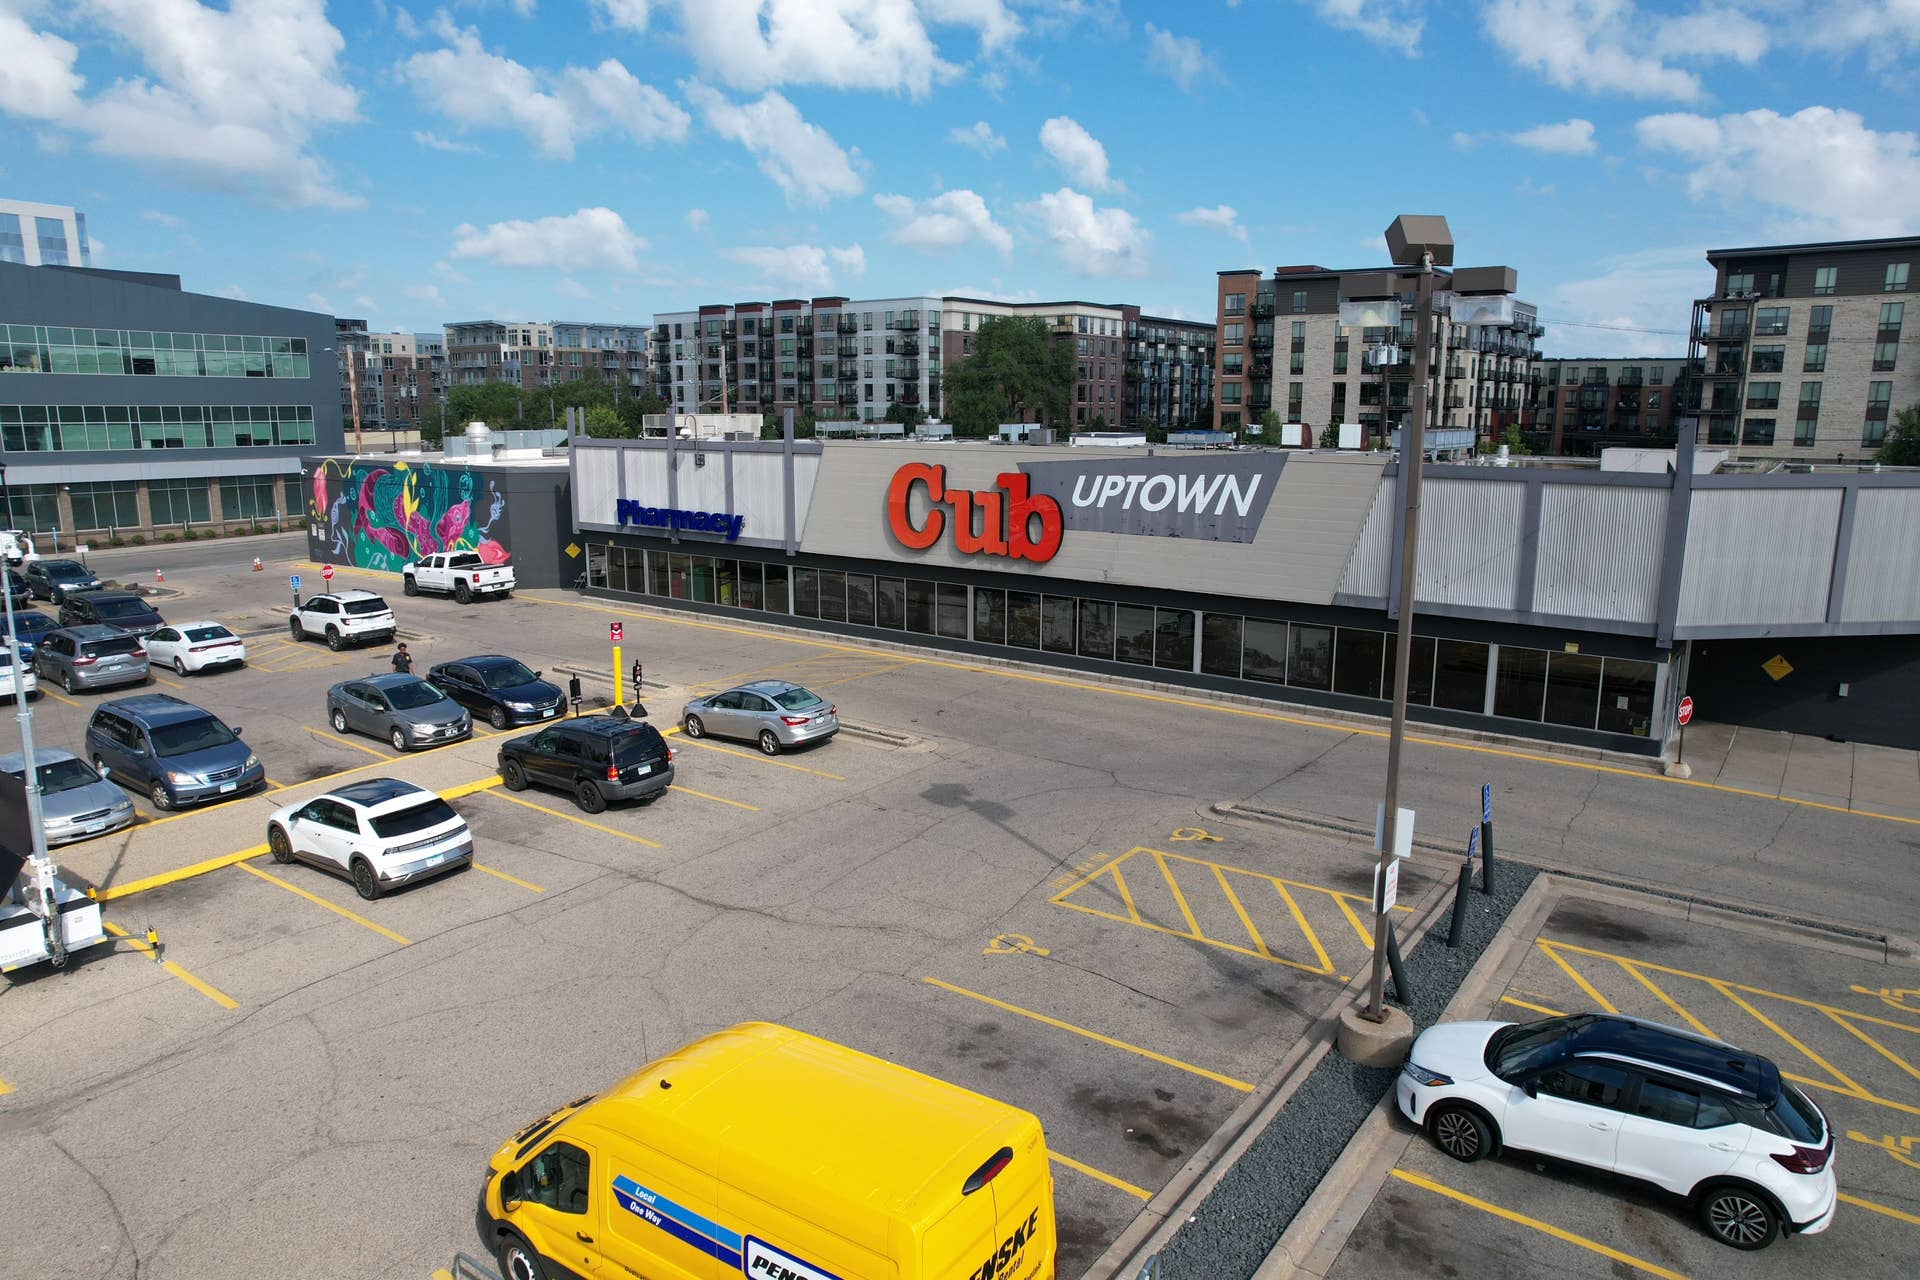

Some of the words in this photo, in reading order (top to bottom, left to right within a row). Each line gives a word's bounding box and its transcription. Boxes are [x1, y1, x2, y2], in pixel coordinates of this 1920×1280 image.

[888, 462, 1064, 563] Cub
[1071, 474, 1262, 517] UPTOWN
[616, 498, 744, 542] Pharmacy
[630, 1201, 645, 1216] One
[645, 1208, 662, 1226] Way
[635, 1186, 656, 1204] Local
